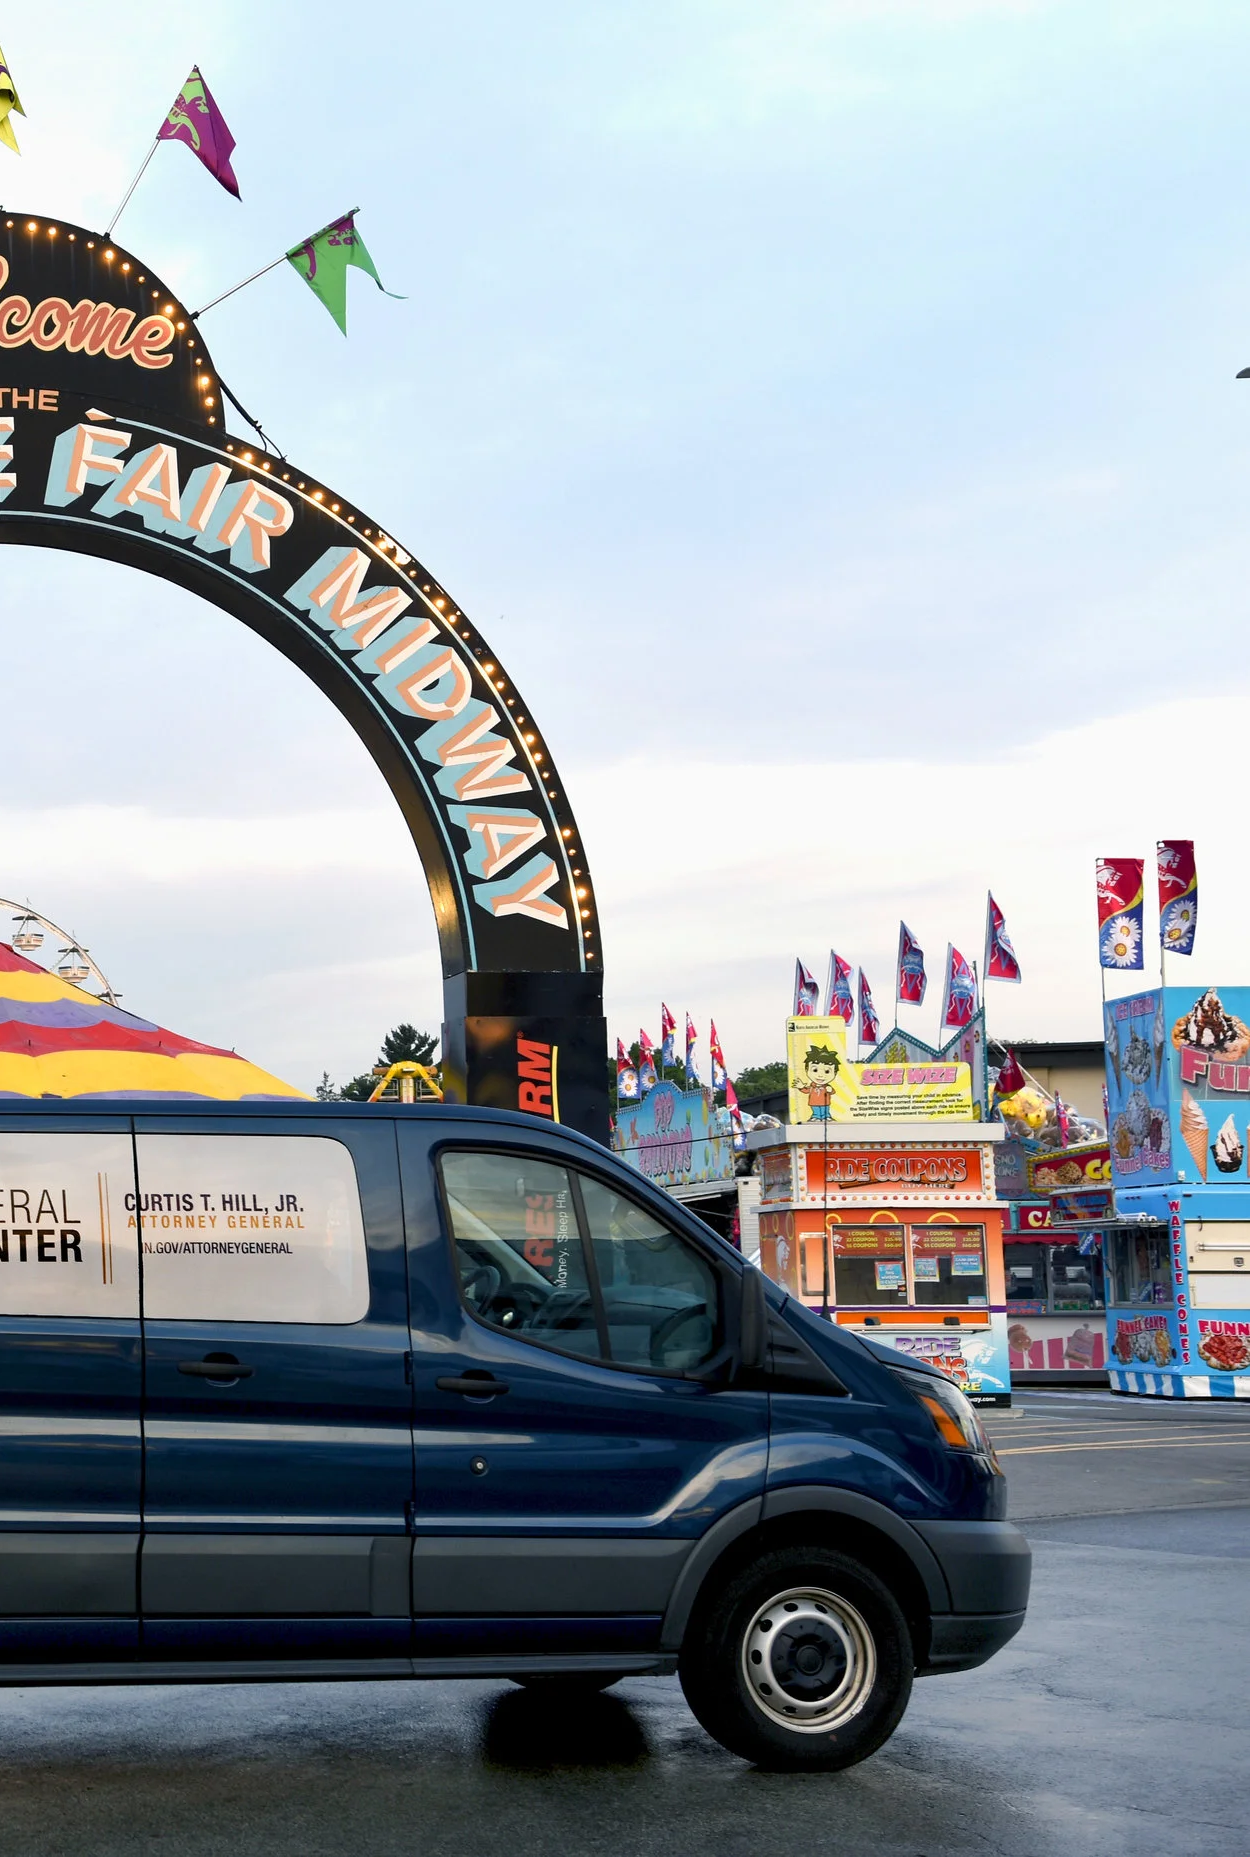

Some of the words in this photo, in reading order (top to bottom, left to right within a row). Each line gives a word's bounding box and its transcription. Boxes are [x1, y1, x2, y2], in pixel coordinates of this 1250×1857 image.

[45, 423, 295, 573] FAIR
[283, 546, 569, 930] MIDWAY
[517, 1037, 553, 1116] RM
[860, 1068, 905, 1085] SIZE
[907, 1067, 958, 1084] WIZE
[825, 1158, 869, 1182] RIDE
[873, 1157, 967, 1182] COUPONS
[124, 1193, 194, 1212] CURTIS
[200, 1194, 215, 1212] T.
[222, 1194, 269, 1215] HILL,
[275, 1194, 304, 1212] JR.
[127, 1215, 217, 1228] ATTORNEY
[227, 1215, 305, 1229] GENERAL
[557, 1211, 569, 1243] Sleep
[142, 1241, 293, 1254] IN.GOV/ATTORNEYGENERAL
[1168, 1200, 1184, 1285] WAFFLE
[1177, 1294, 1191, 1364] CONES
